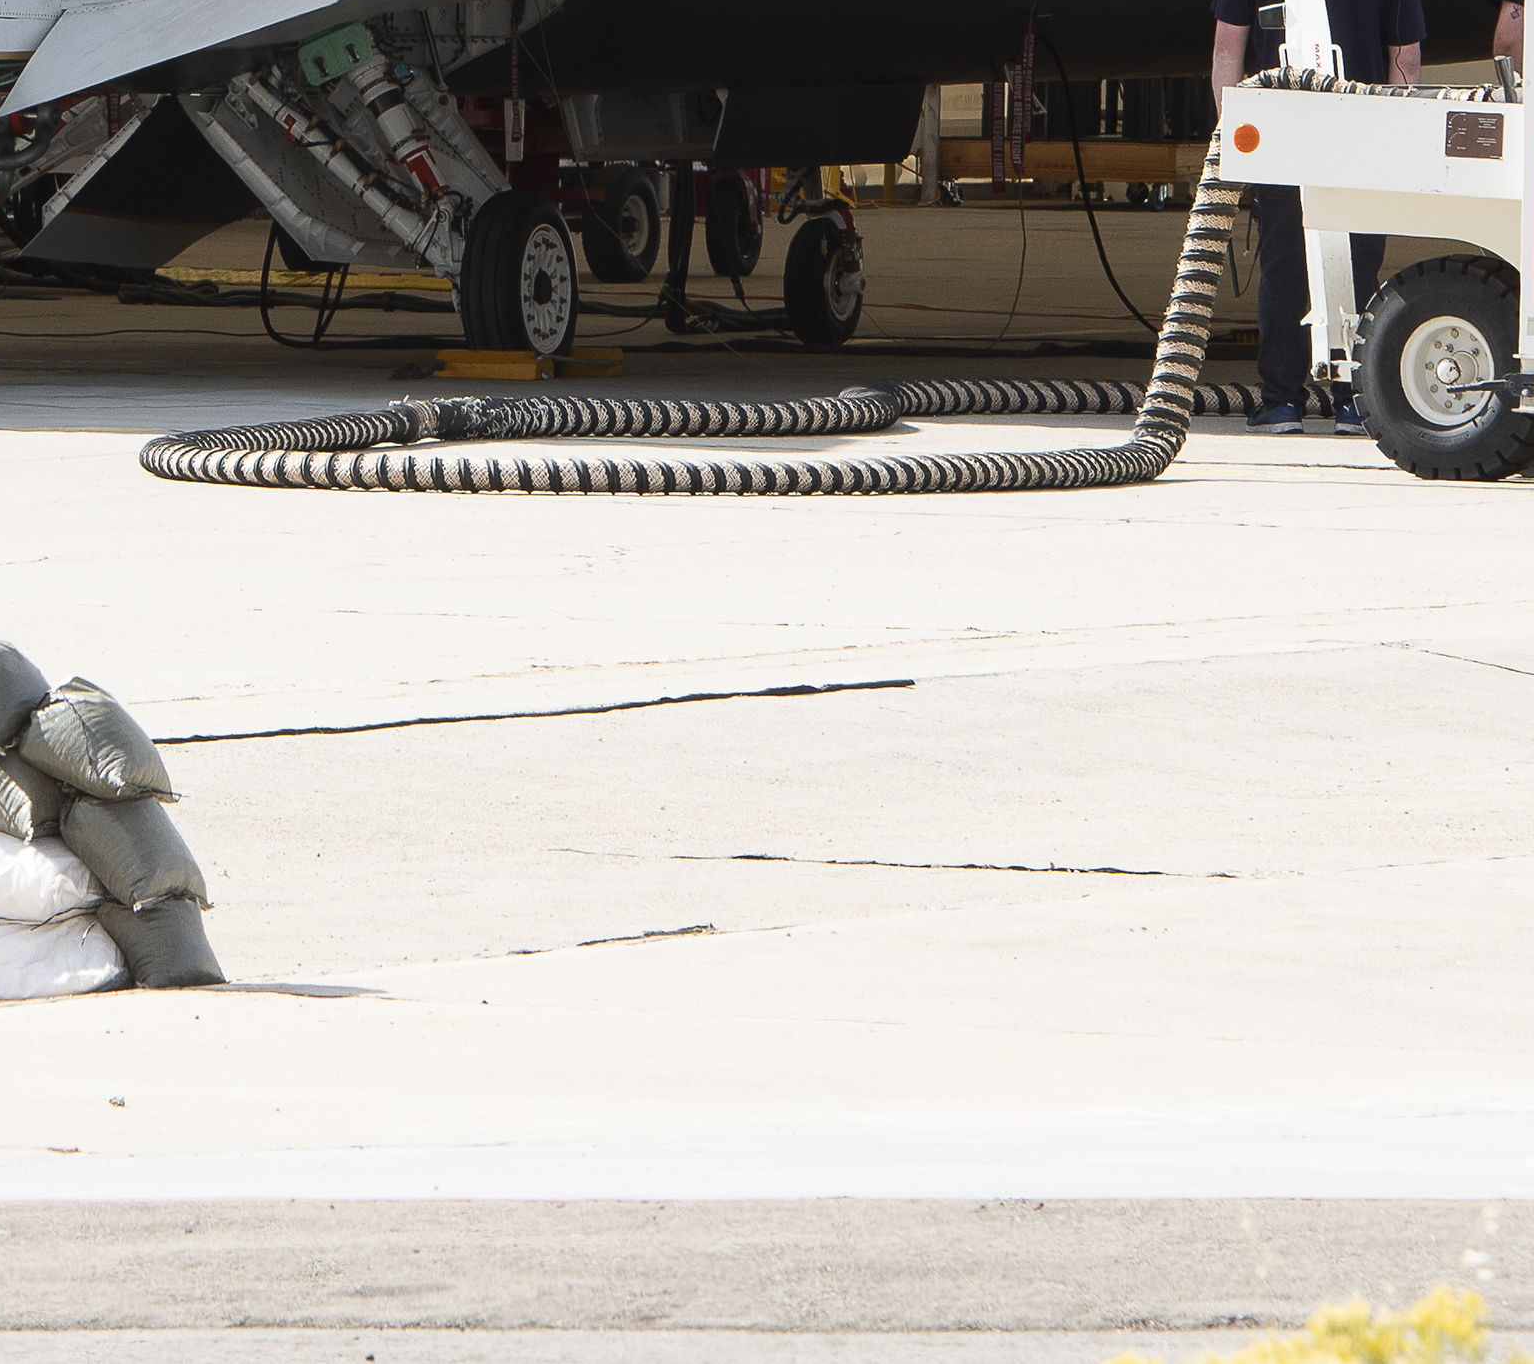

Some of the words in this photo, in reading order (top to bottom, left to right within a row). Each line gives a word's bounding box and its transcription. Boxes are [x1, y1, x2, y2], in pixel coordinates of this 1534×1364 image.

[1014, 64, 1022, 100] REMOVE
[994, 82, 1003, 118] REMOVE
[1013, 101, 1022, 134] BEFORE
[993, 119, 1004, 152] BEFORE
[1011, 136, 1021, 165] FLIGHT
[993, 153, 1004, 183] FLIGHT
